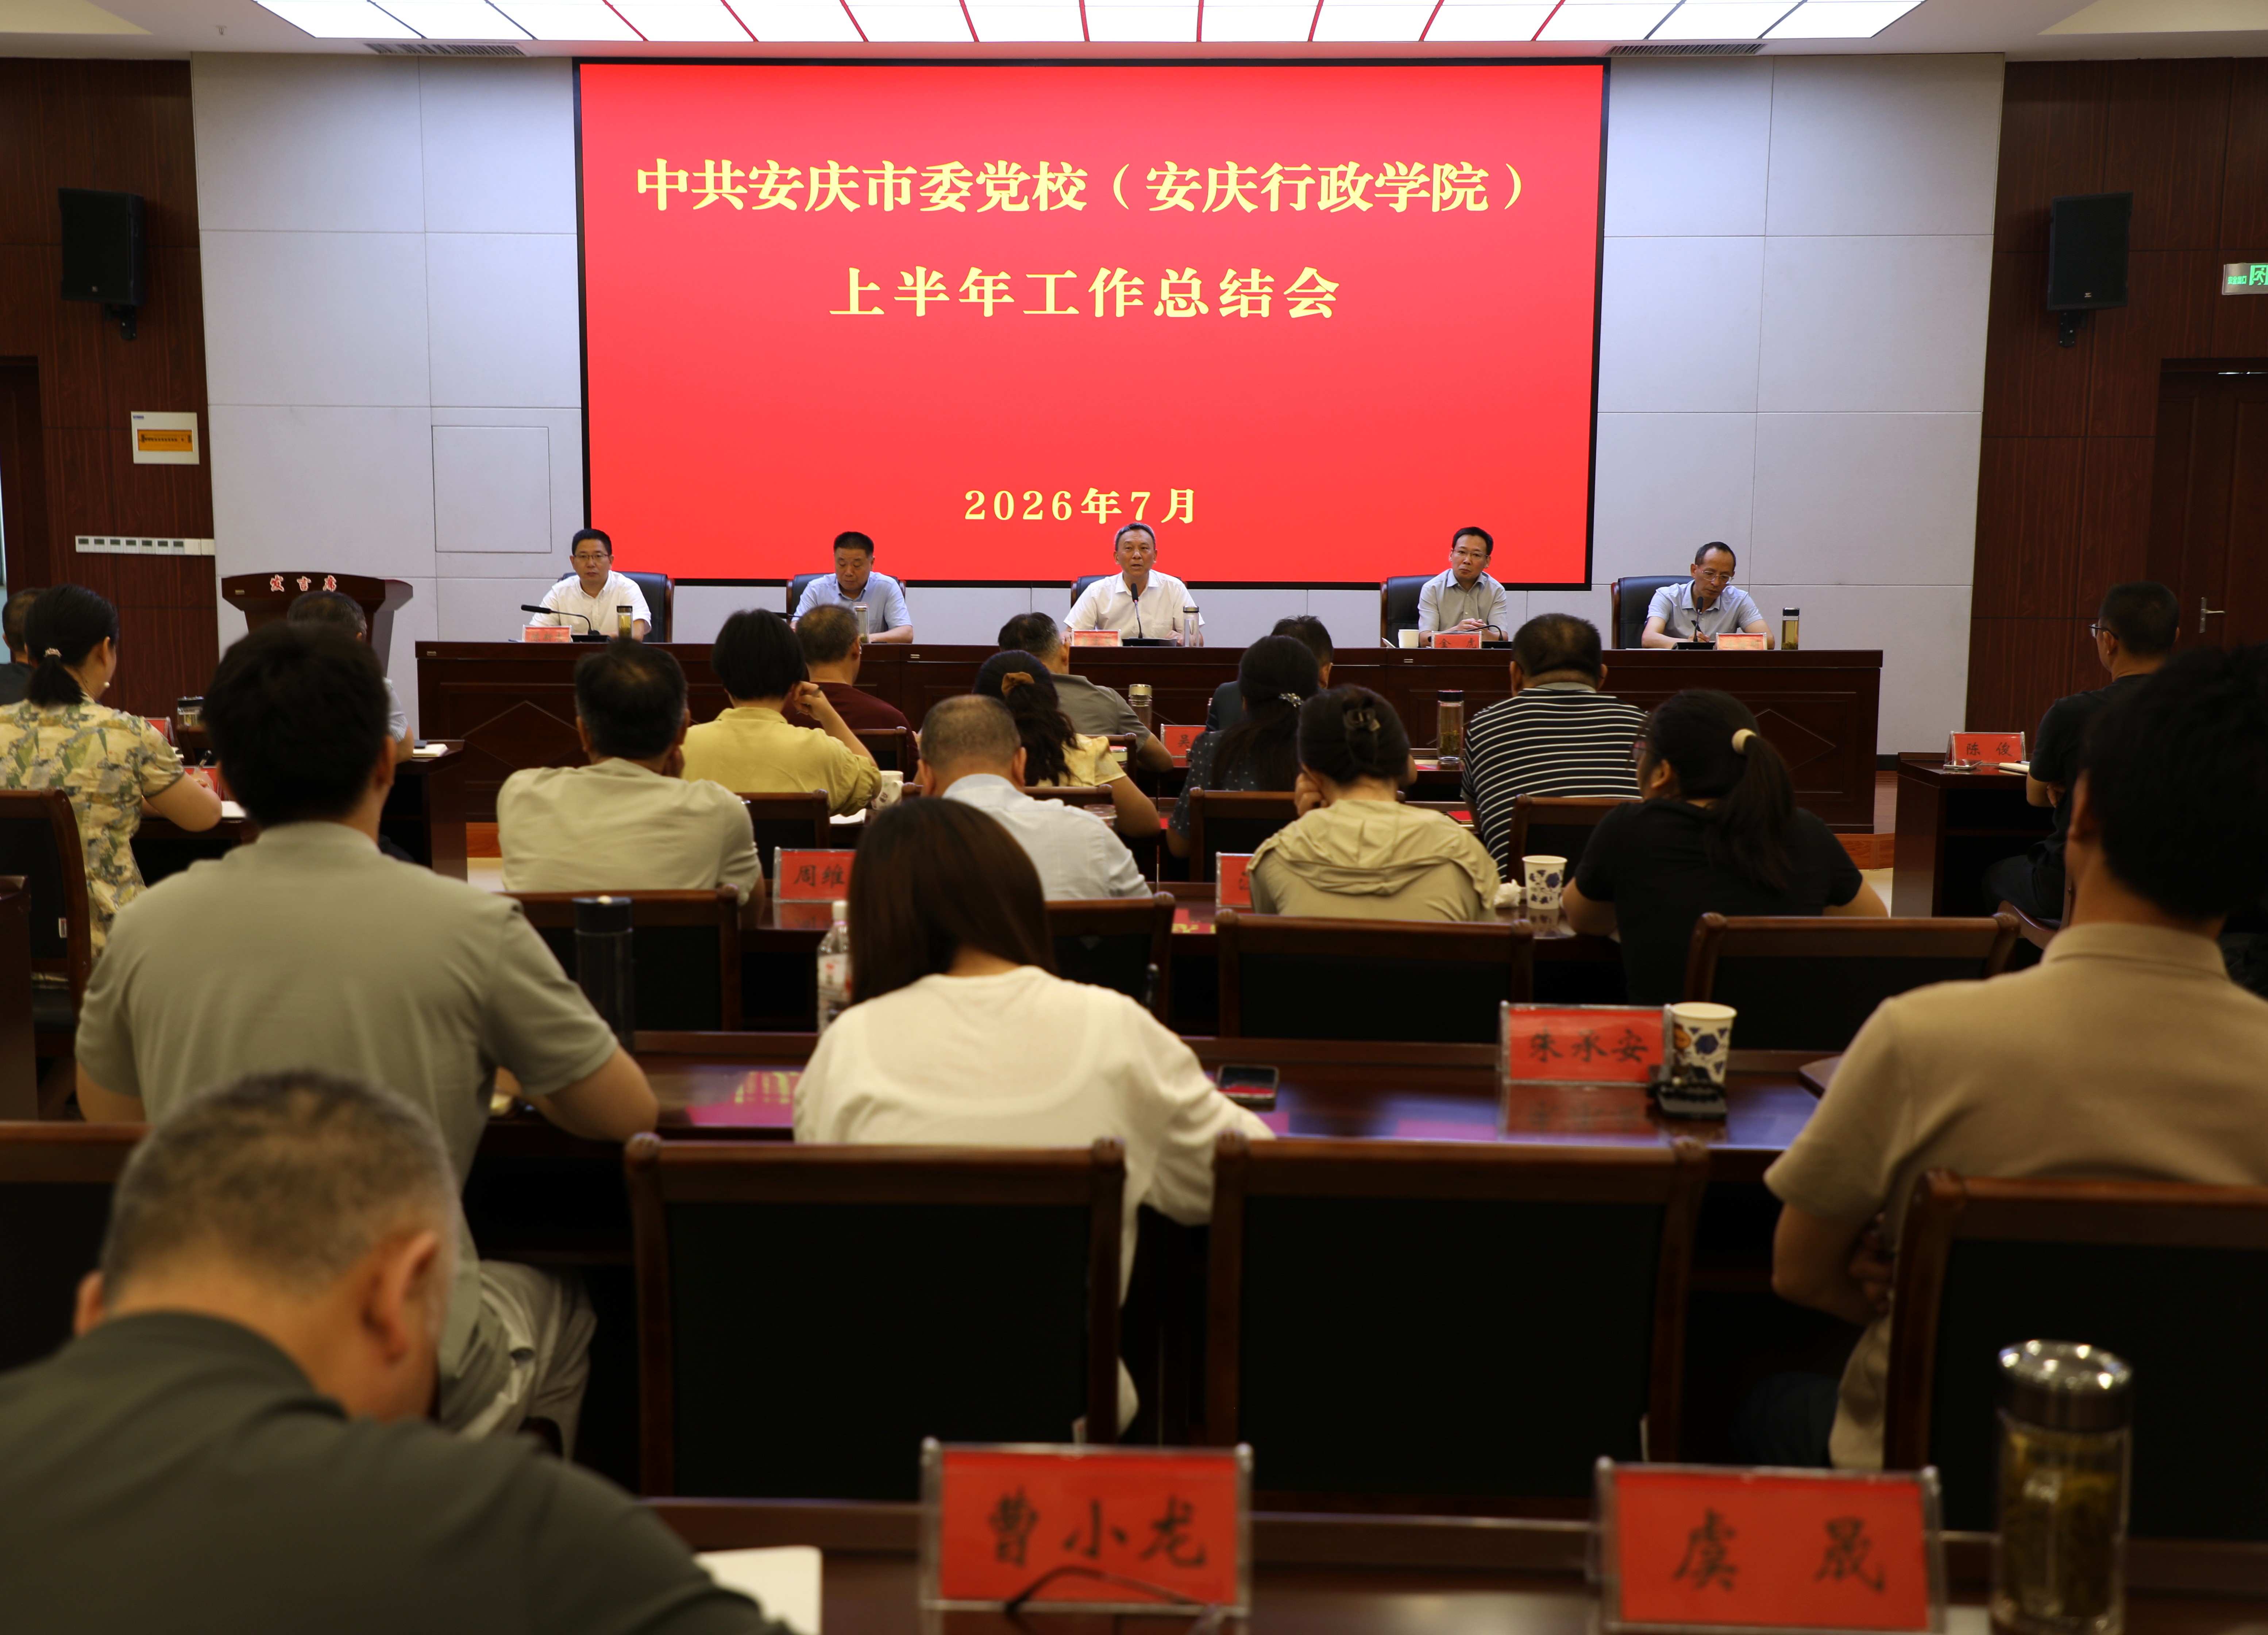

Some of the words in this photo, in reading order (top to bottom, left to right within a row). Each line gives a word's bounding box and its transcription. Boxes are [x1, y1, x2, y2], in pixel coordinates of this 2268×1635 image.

[2228, 276, 2247, 284] 安全出口
[829, 265, 1340, 318] 上半年工作总结会
[964, 487, 1195, 524] 2026年7月
[270, 574, 337, 592] 发言席
[1439, 638, 1477, 648] 金虎
[1178, 734, 1190, 747] 吴
[1966, 742, 2013, 757] 陈俊
[989, 1486, 1207, 1568] 曹小龙
